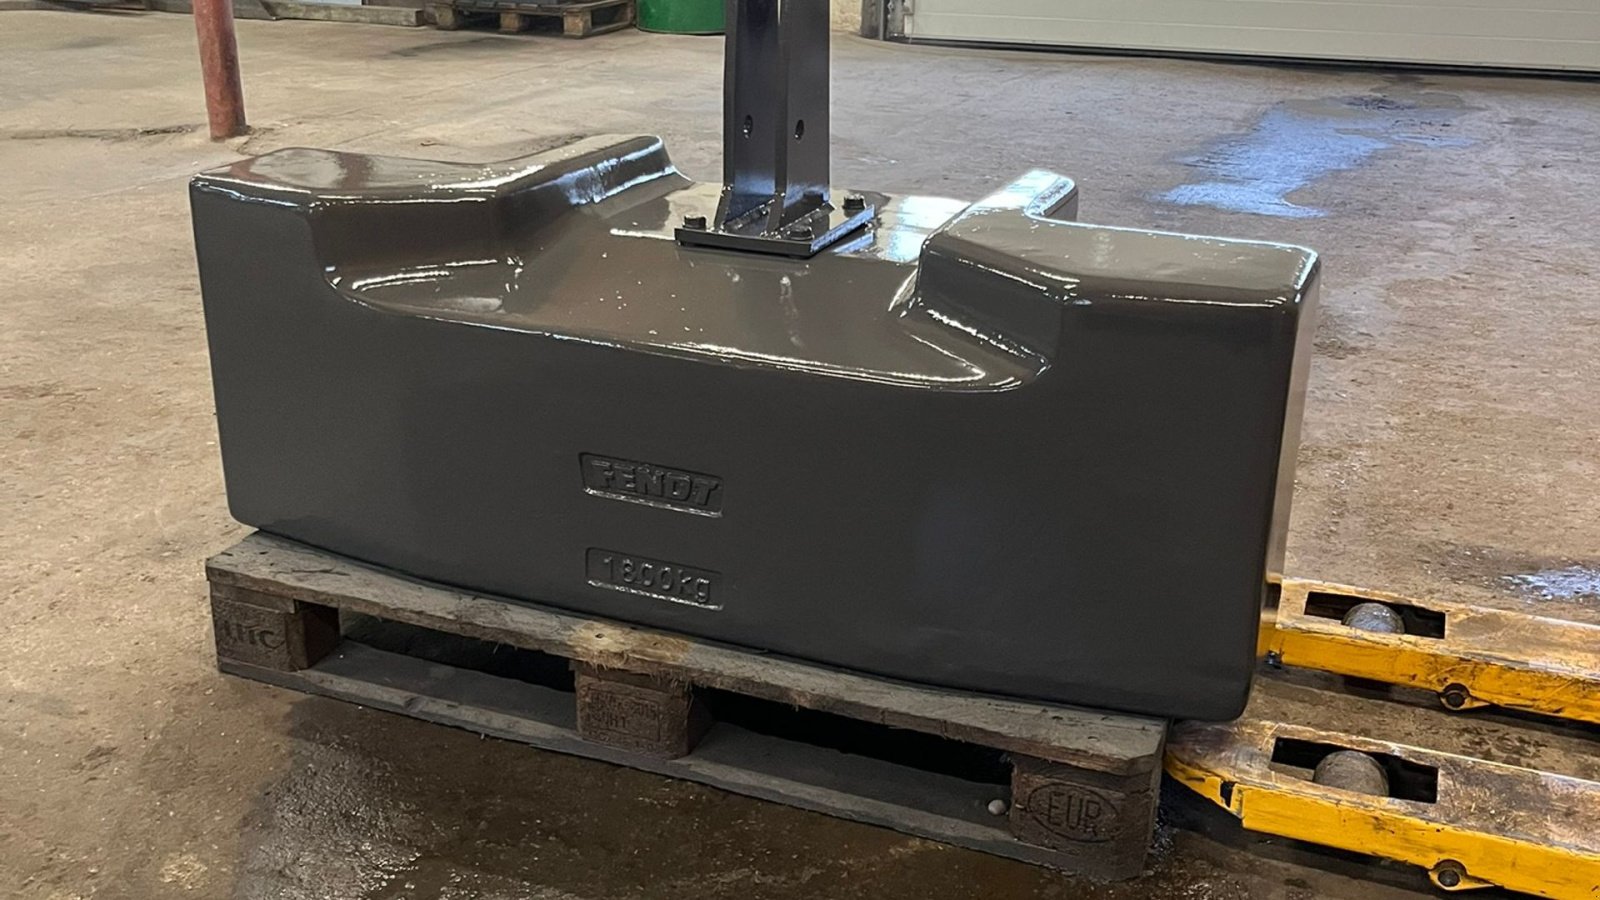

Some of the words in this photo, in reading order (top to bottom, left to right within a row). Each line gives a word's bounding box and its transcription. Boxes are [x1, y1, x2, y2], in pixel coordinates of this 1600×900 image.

[591, 460, 719, 506] FENDT
[603, 556, 711, 603] 1800kg
[1048, 791, 1101, 837] EUR
